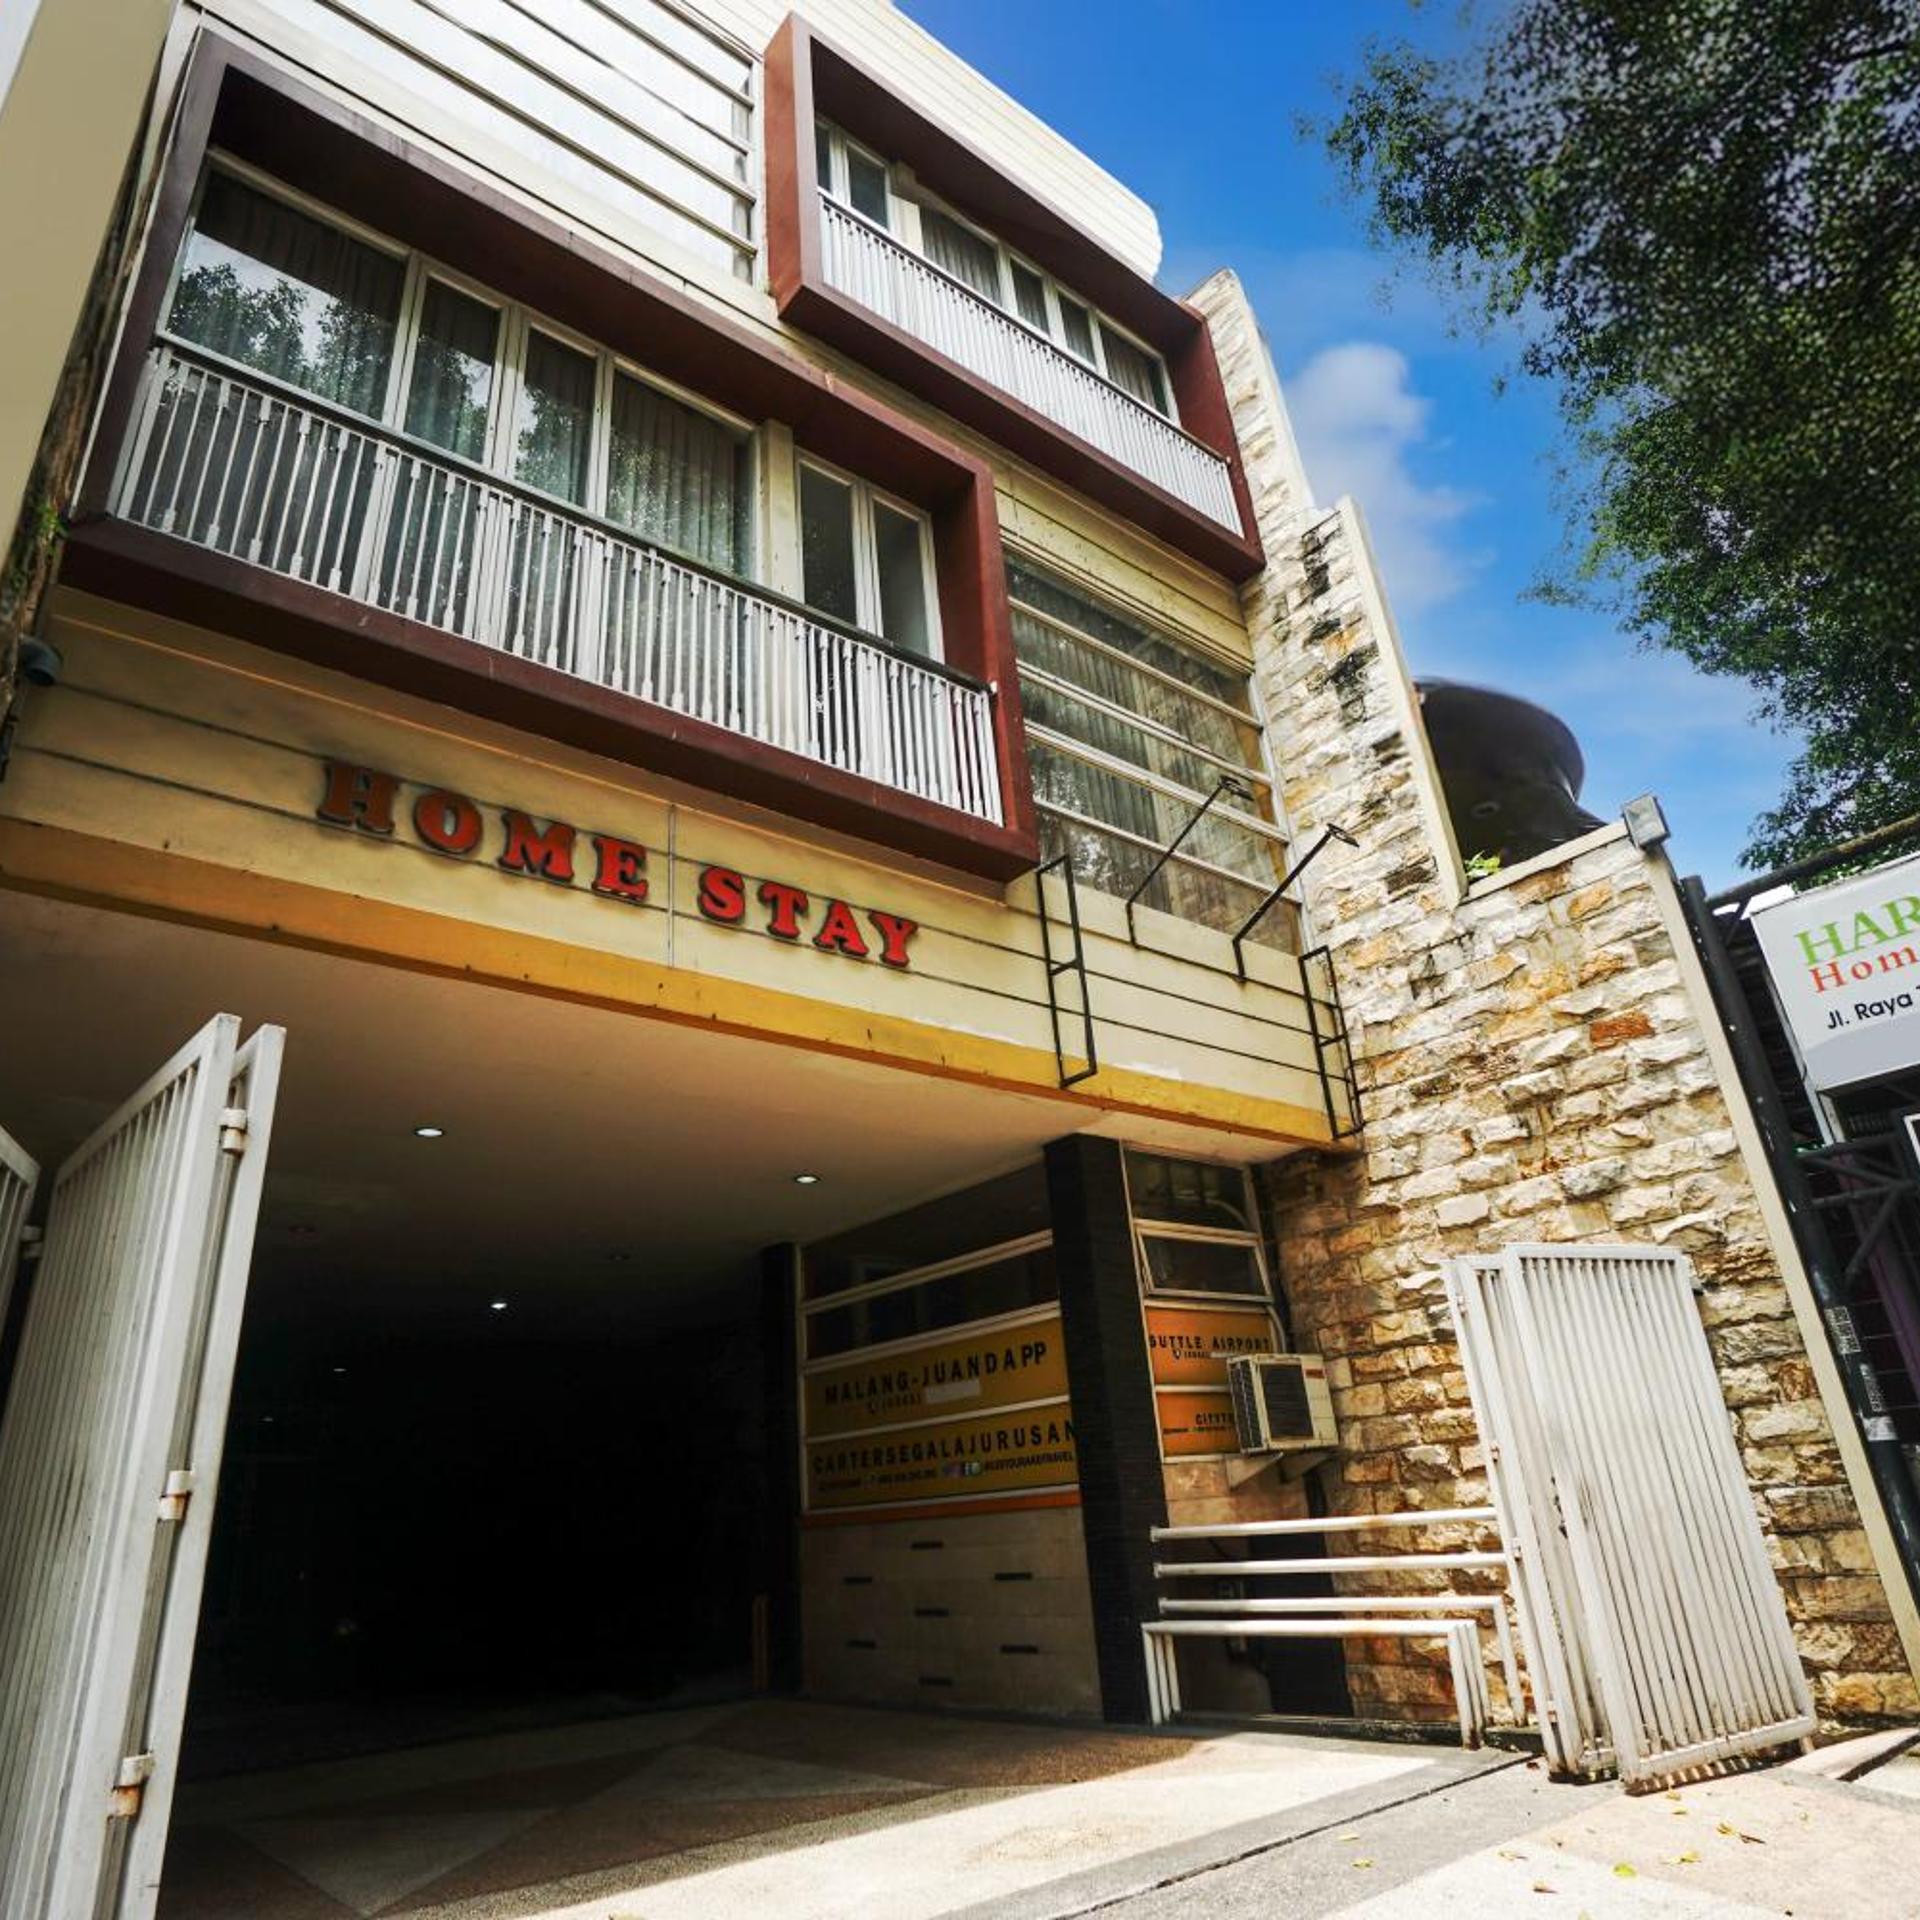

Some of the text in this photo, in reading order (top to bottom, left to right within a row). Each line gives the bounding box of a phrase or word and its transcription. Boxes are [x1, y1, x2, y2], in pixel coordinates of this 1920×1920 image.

[316, 759, 919, 968] HOME STAY
[1795, 895, 1920, 966] HAR
[1809, 946, 1920, 993] Hom
[1827, 993, 1913, 1029] Jl. Raya
[1212, 1335, 1270, 1351] AIRPORT
